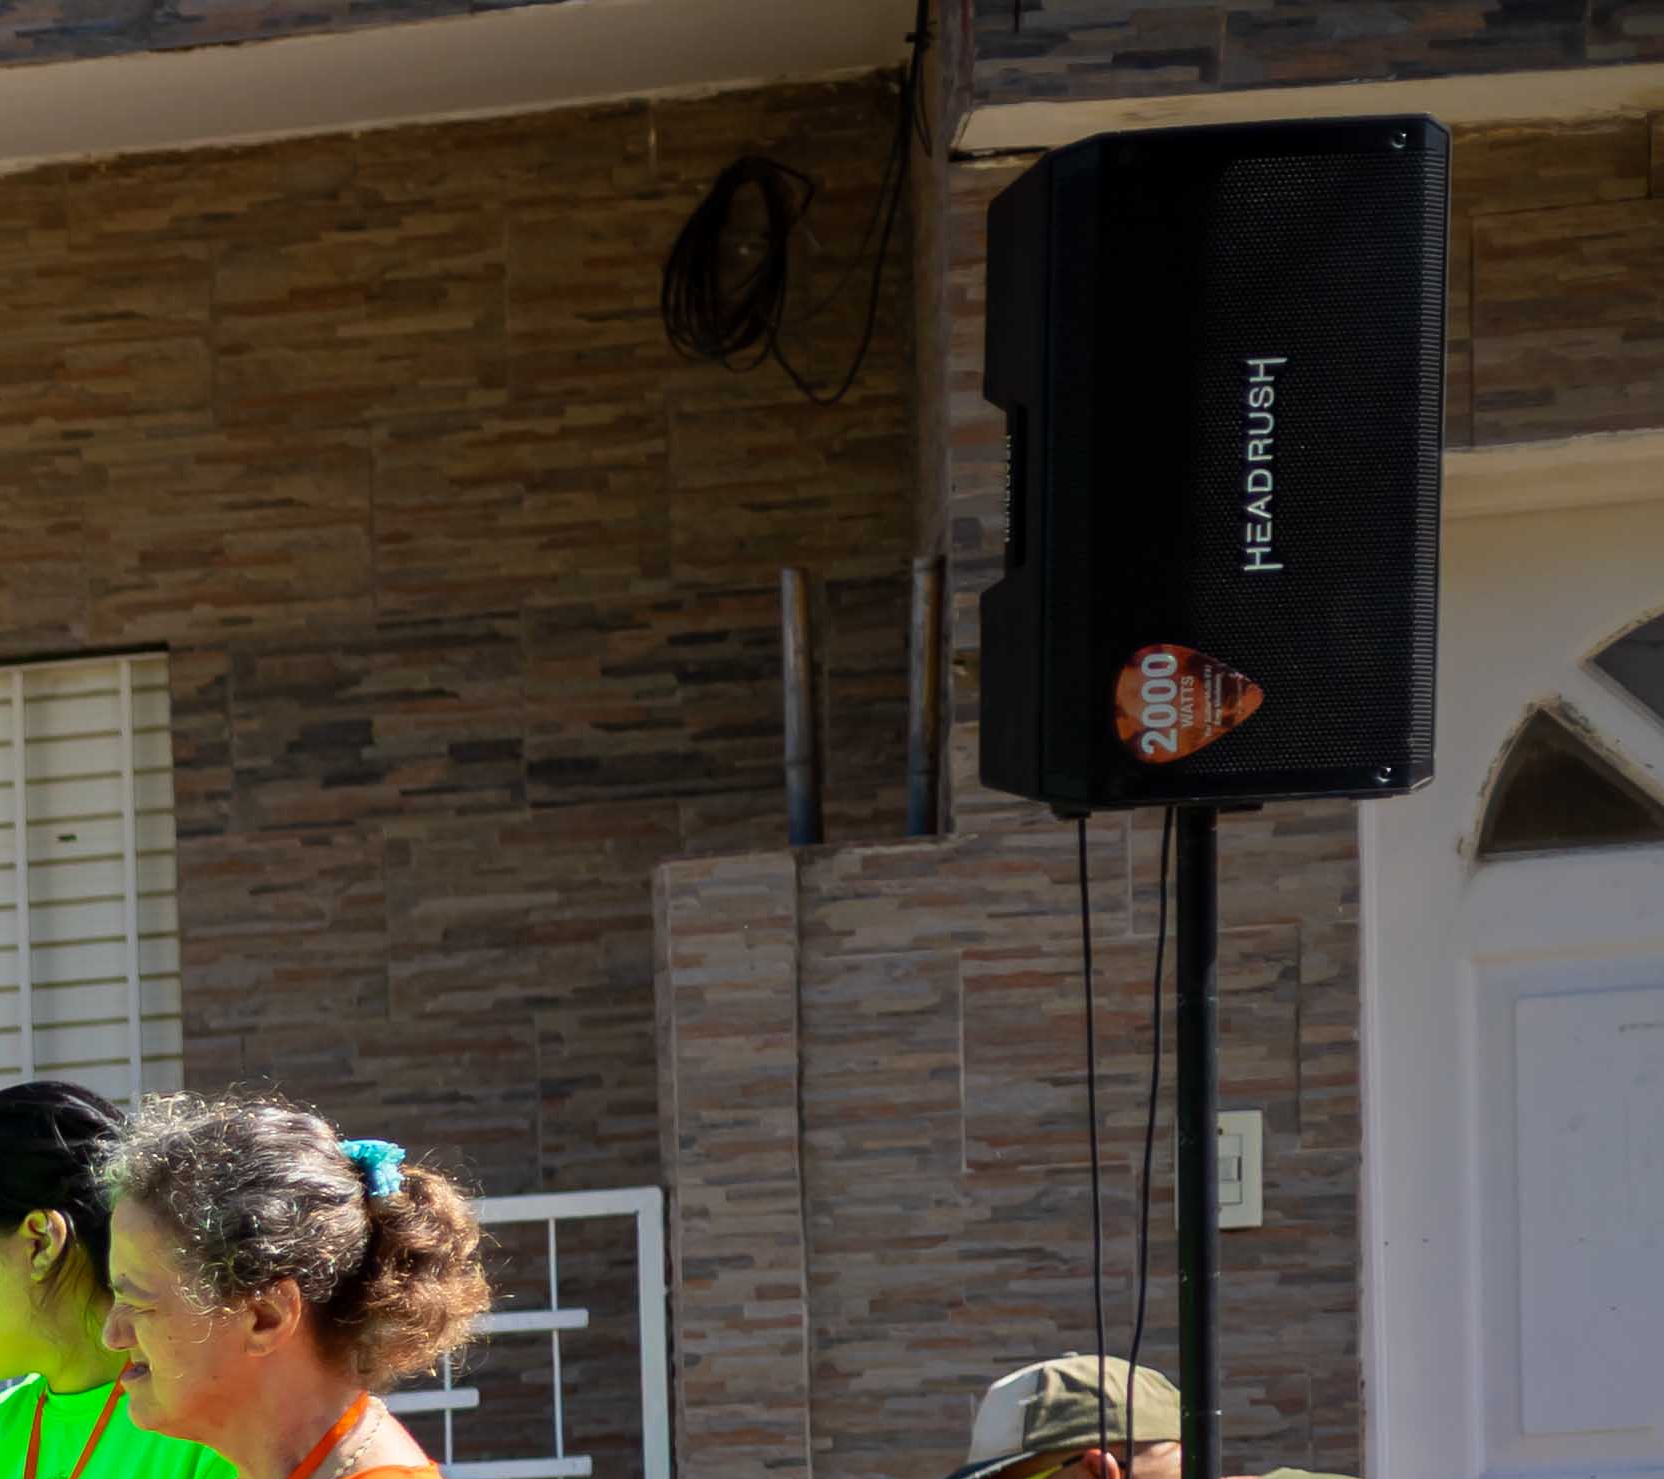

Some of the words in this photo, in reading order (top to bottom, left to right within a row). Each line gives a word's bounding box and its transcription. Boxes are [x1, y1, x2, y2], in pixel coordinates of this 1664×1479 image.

[1243, 356, 1288, 572] HEADRUSH
[1140, 653, 1178, 754] 2000
[1180, 676, 1195, 729] WATTS
